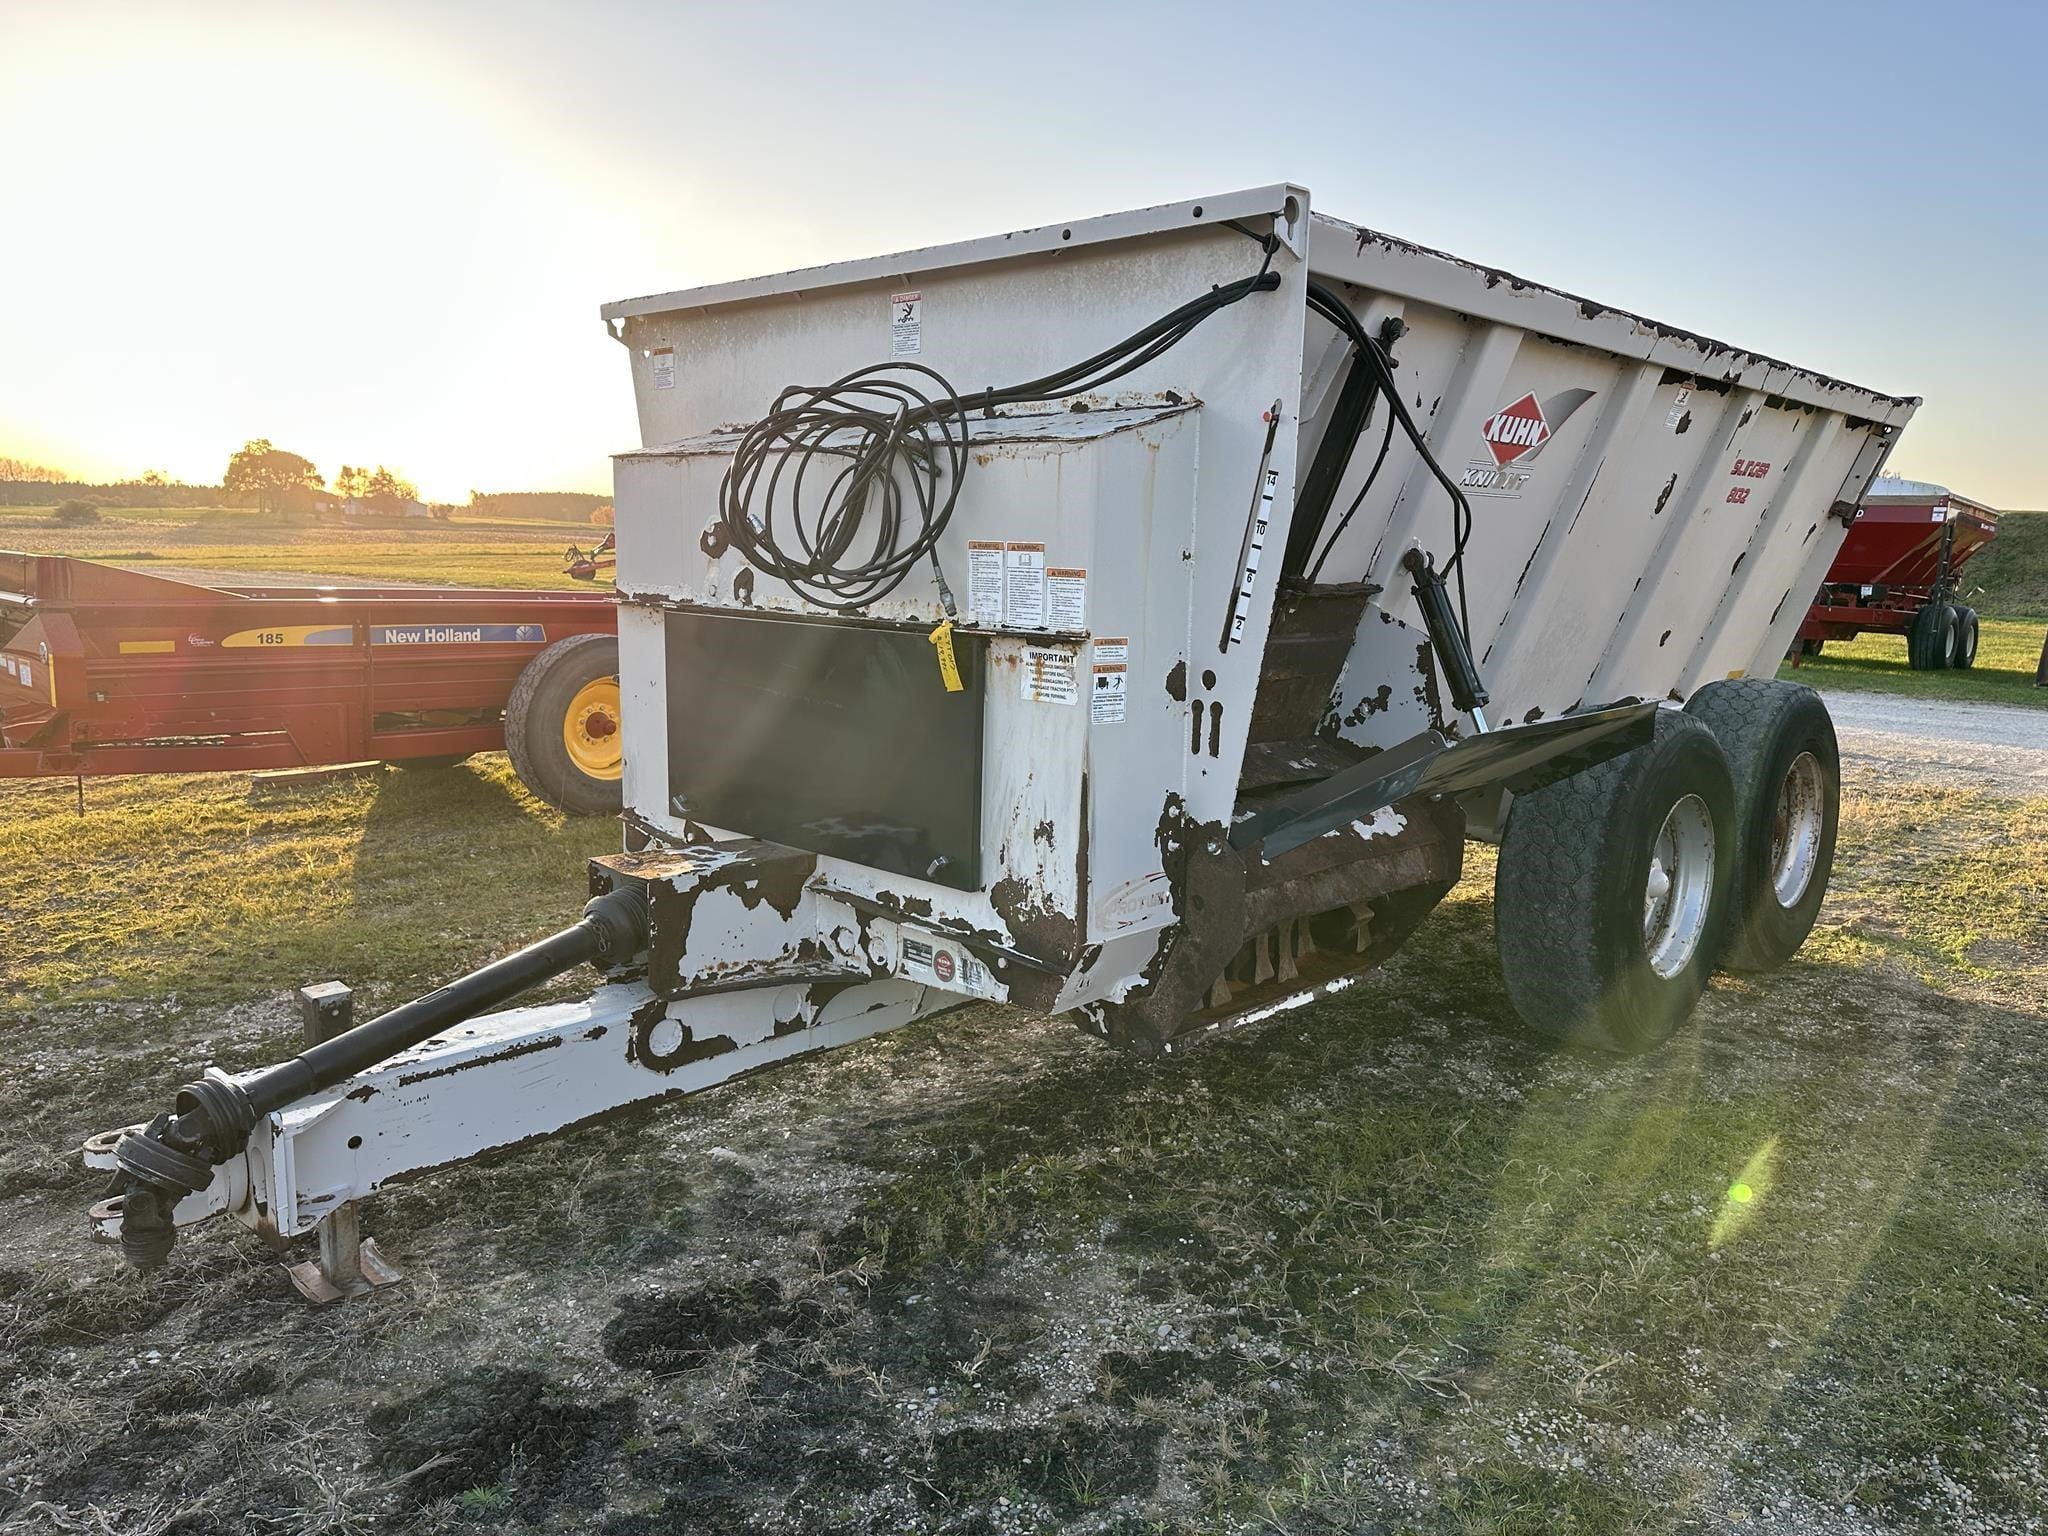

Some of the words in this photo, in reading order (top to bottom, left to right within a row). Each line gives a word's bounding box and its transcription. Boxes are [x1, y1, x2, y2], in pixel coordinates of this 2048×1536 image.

[1486, 414, 1545, 447] KUHN
[1730, 459, 1770, 479] SLINGER
[1266, 475, 1276, 487] 14
[1256, 524, 1266, 536] 10
[1057, 570, 1081, 578] WARNING
[1246, 573, 1253, 583] 6
[1235, 620, 1242, 630] 2
[257, 633, 284, 644] 185
[385, 630, 420, 643] New
[425, 628, 481, 642] Holland
[1029, 651, 1075, 664] IMPORTANT
